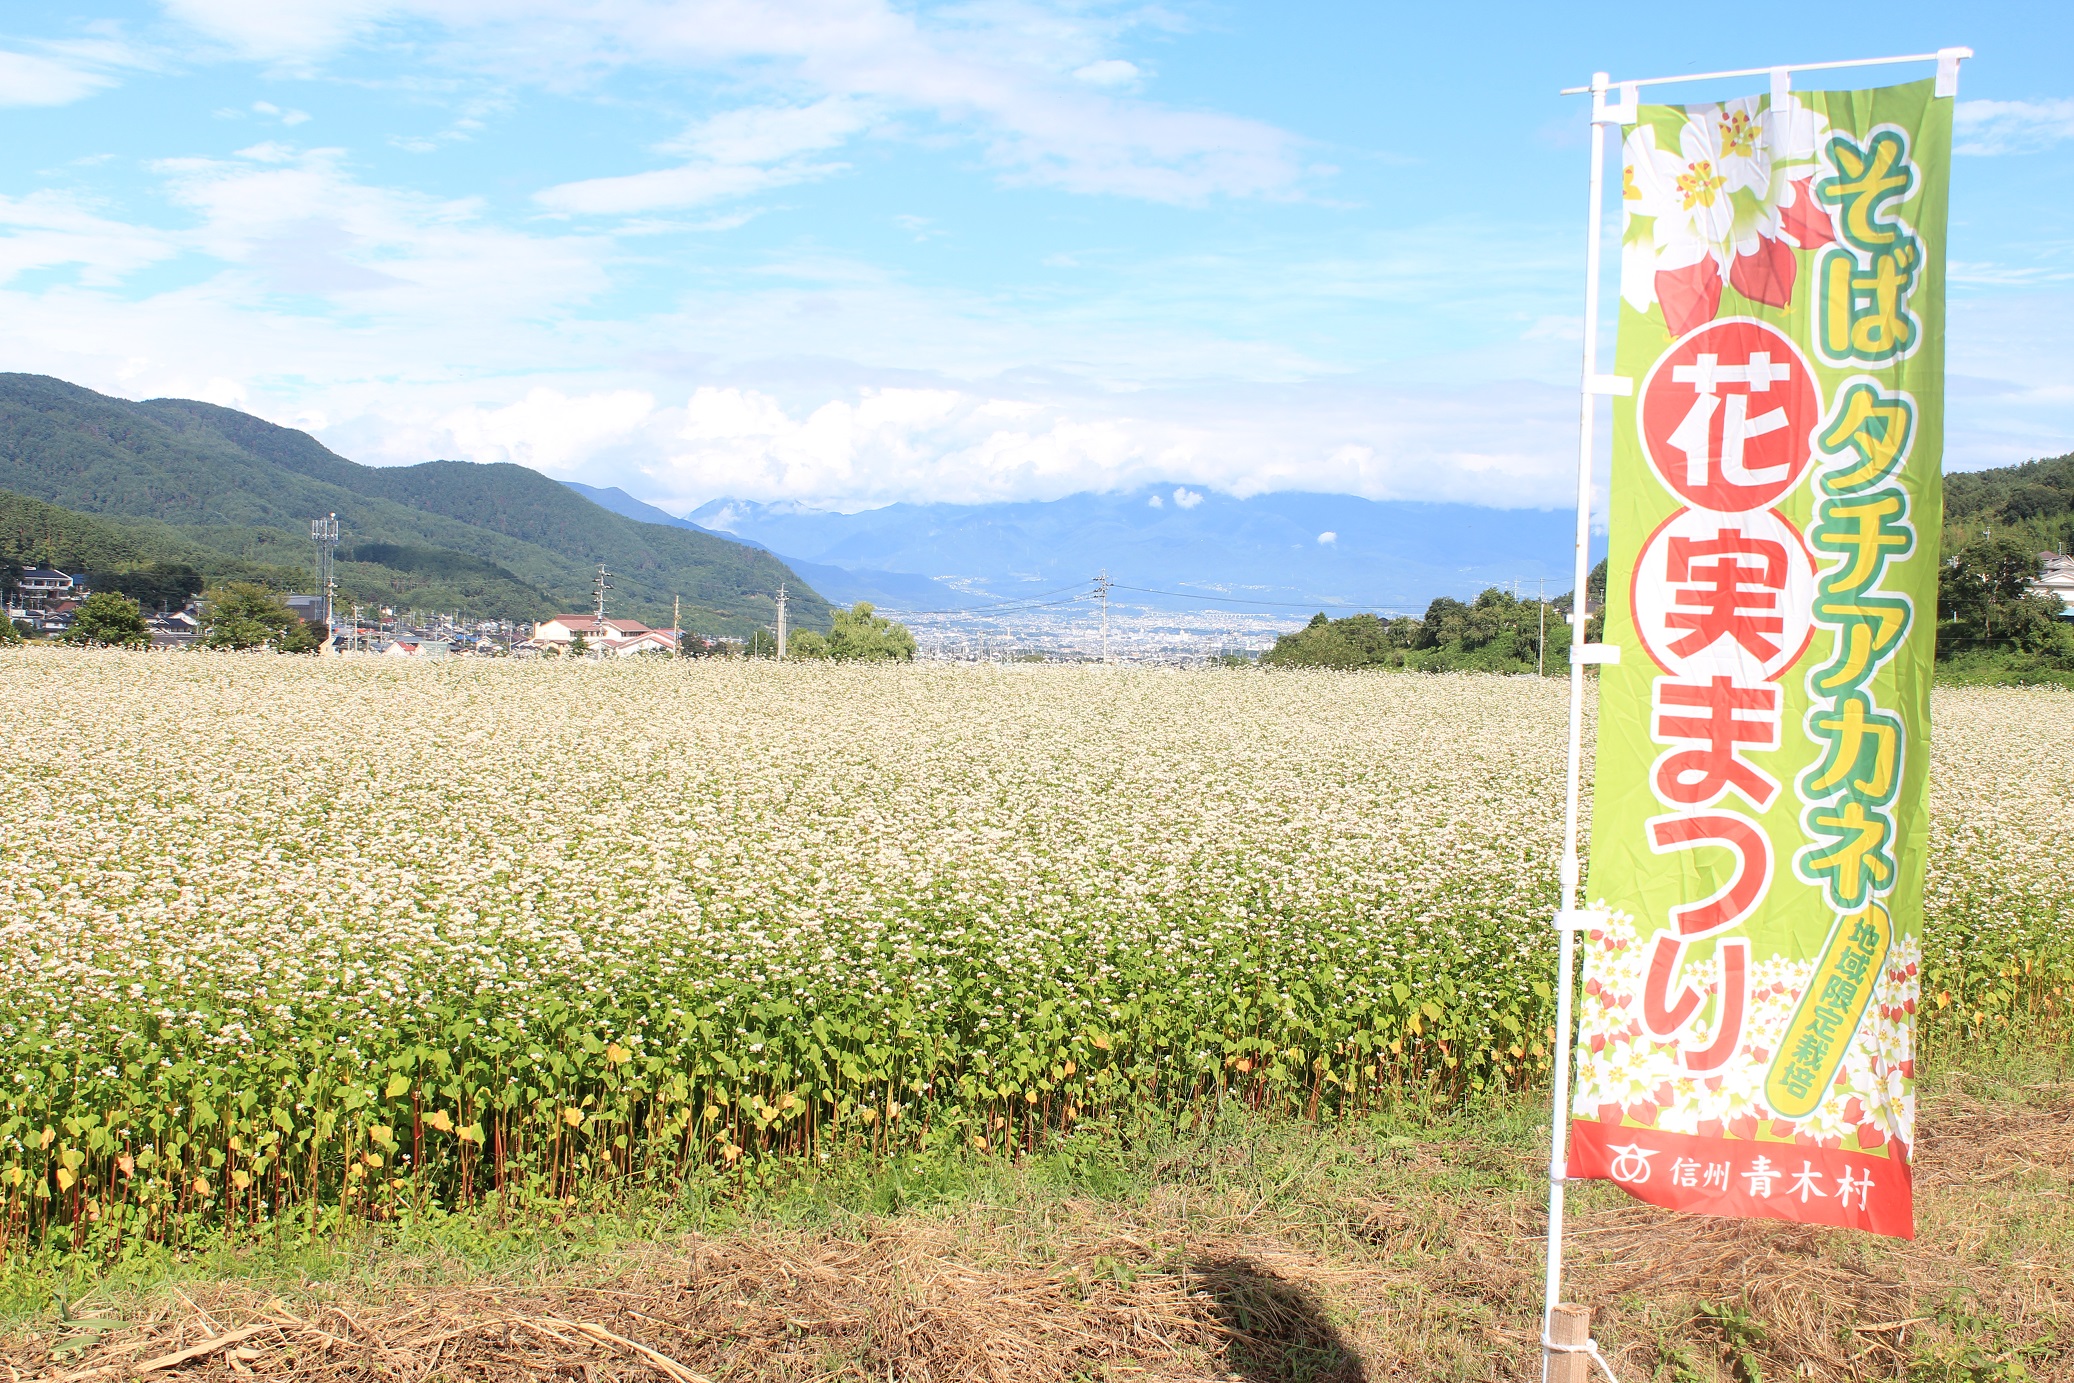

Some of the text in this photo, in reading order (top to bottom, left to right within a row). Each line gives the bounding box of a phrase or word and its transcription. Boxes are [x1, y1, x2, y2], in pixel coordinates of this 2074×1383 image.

[1644, 351, 1787, 1070] 花実まつり
[1778, 917, 1880, 1099] 地域限定栽培
